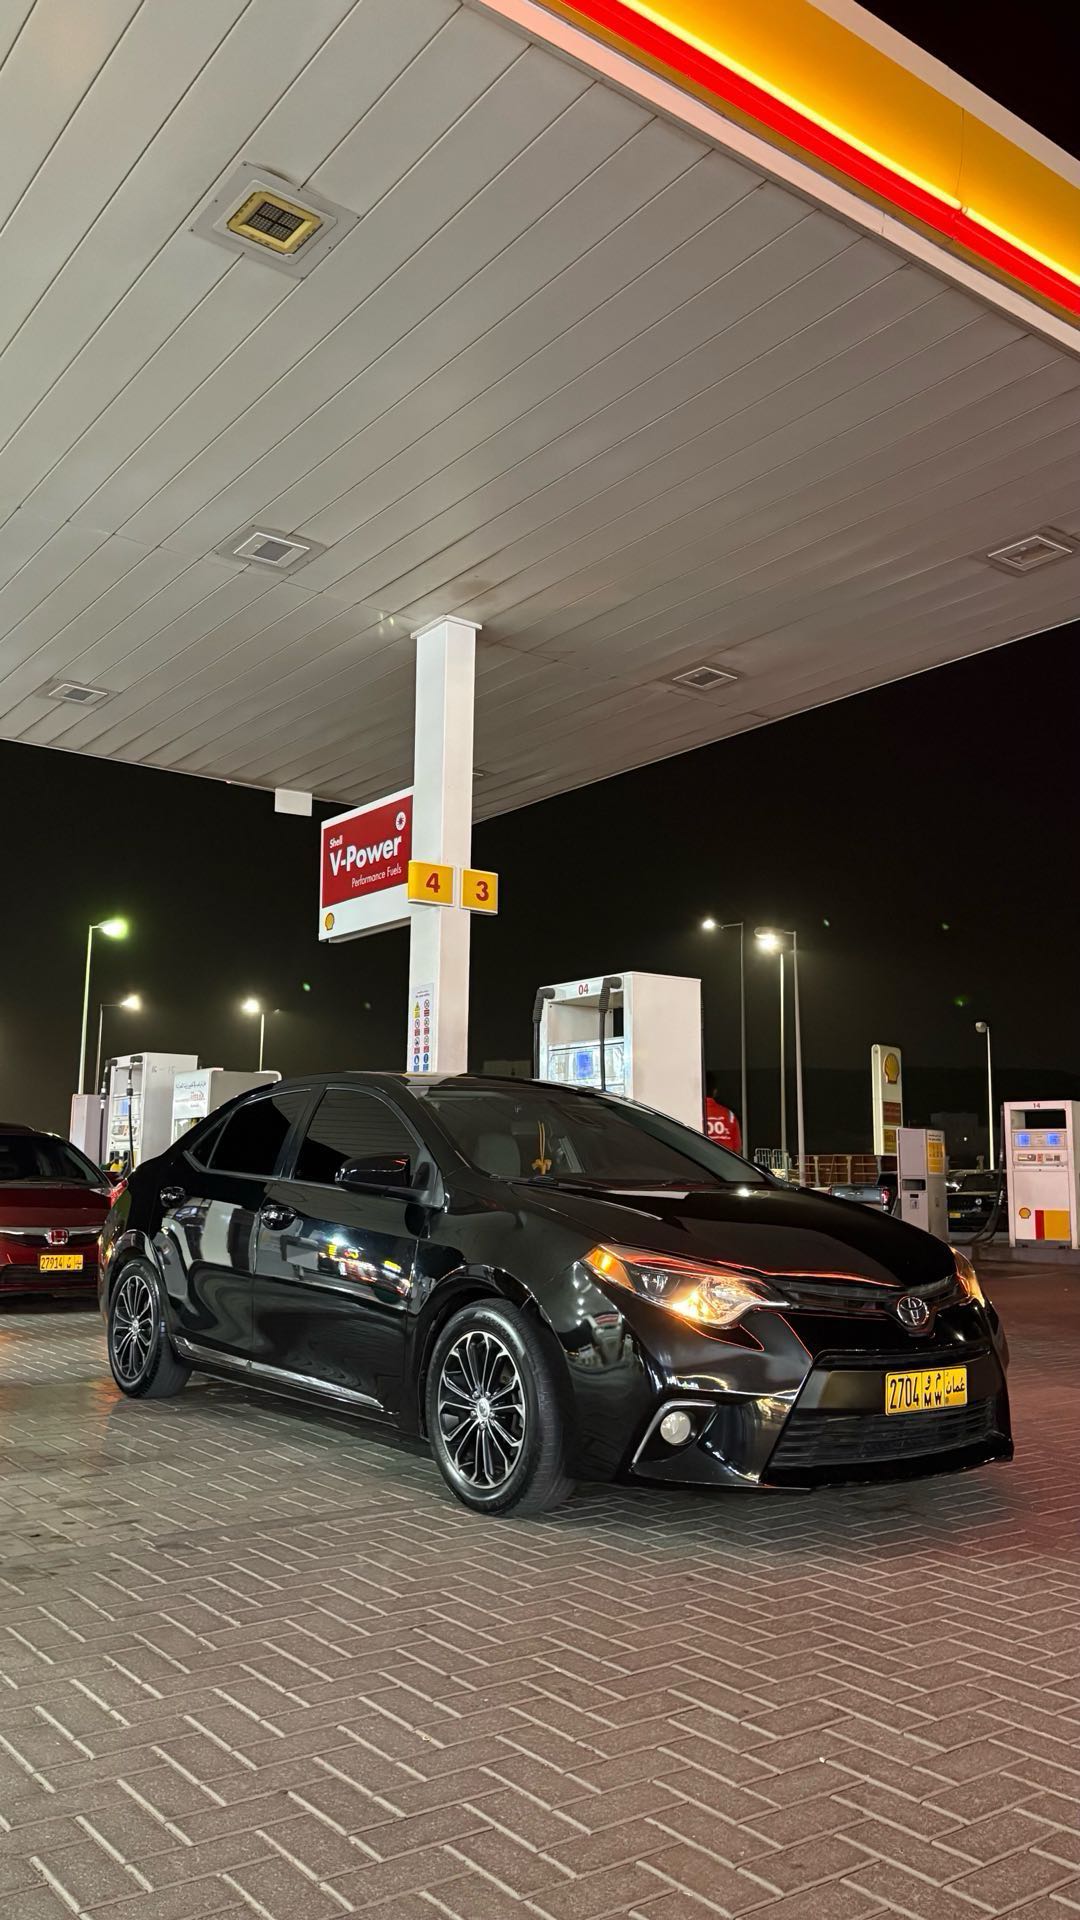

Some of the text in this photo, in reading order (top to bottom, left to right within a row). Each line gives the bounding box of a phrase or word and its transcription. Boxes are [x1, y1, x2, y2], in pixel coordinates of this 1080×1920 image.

[329, 834, 343, 849] Shell
[329, 835, 402, 876] V-Power
[351, 863, 402, 888] Performance Fuels
[425, 872, 440, 893] 4
[475, 880, 490, 901] 3
[578, 983, 589, 995] 04
[889, 1376, 920, 1409] 2704
